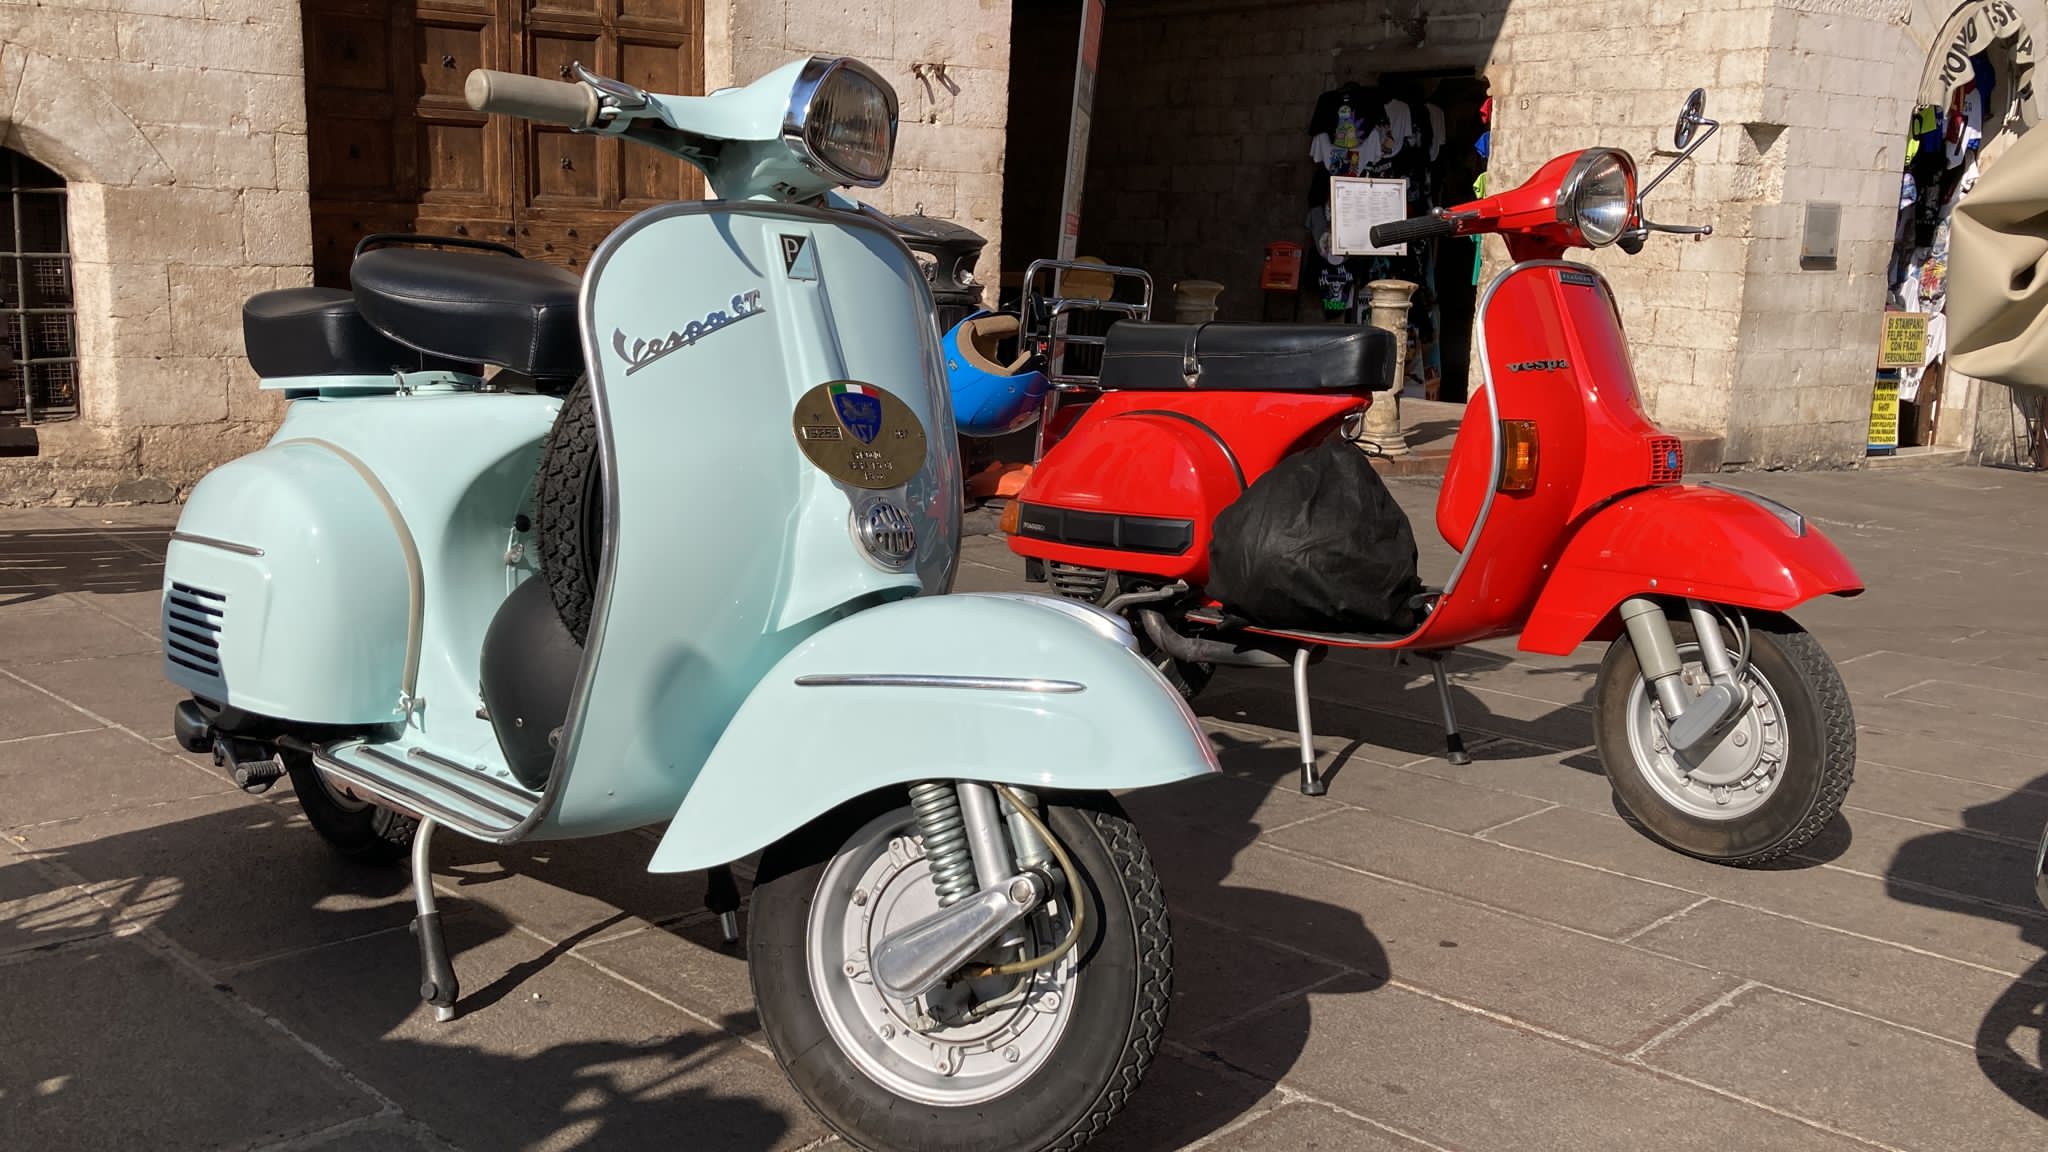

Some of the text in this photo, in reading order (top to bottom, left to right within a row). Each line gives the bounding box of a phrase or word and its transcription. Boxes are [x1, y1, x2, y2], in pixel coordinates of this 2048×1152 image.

[783, 238, 799, 262] P
[1895, 317, 1924, 330] STAMPANO
[612, 307, 733, 370] Vespa
[1887, 330, 1903, 340] FELPE
[1904, 330, 1923, 341] T-SHIRT
[1890, 341, 1902, 351] CON
[1903, 341, 1918, 351] FRASI
[1884, 352, 1922, 363] PERSONALIZZATE
